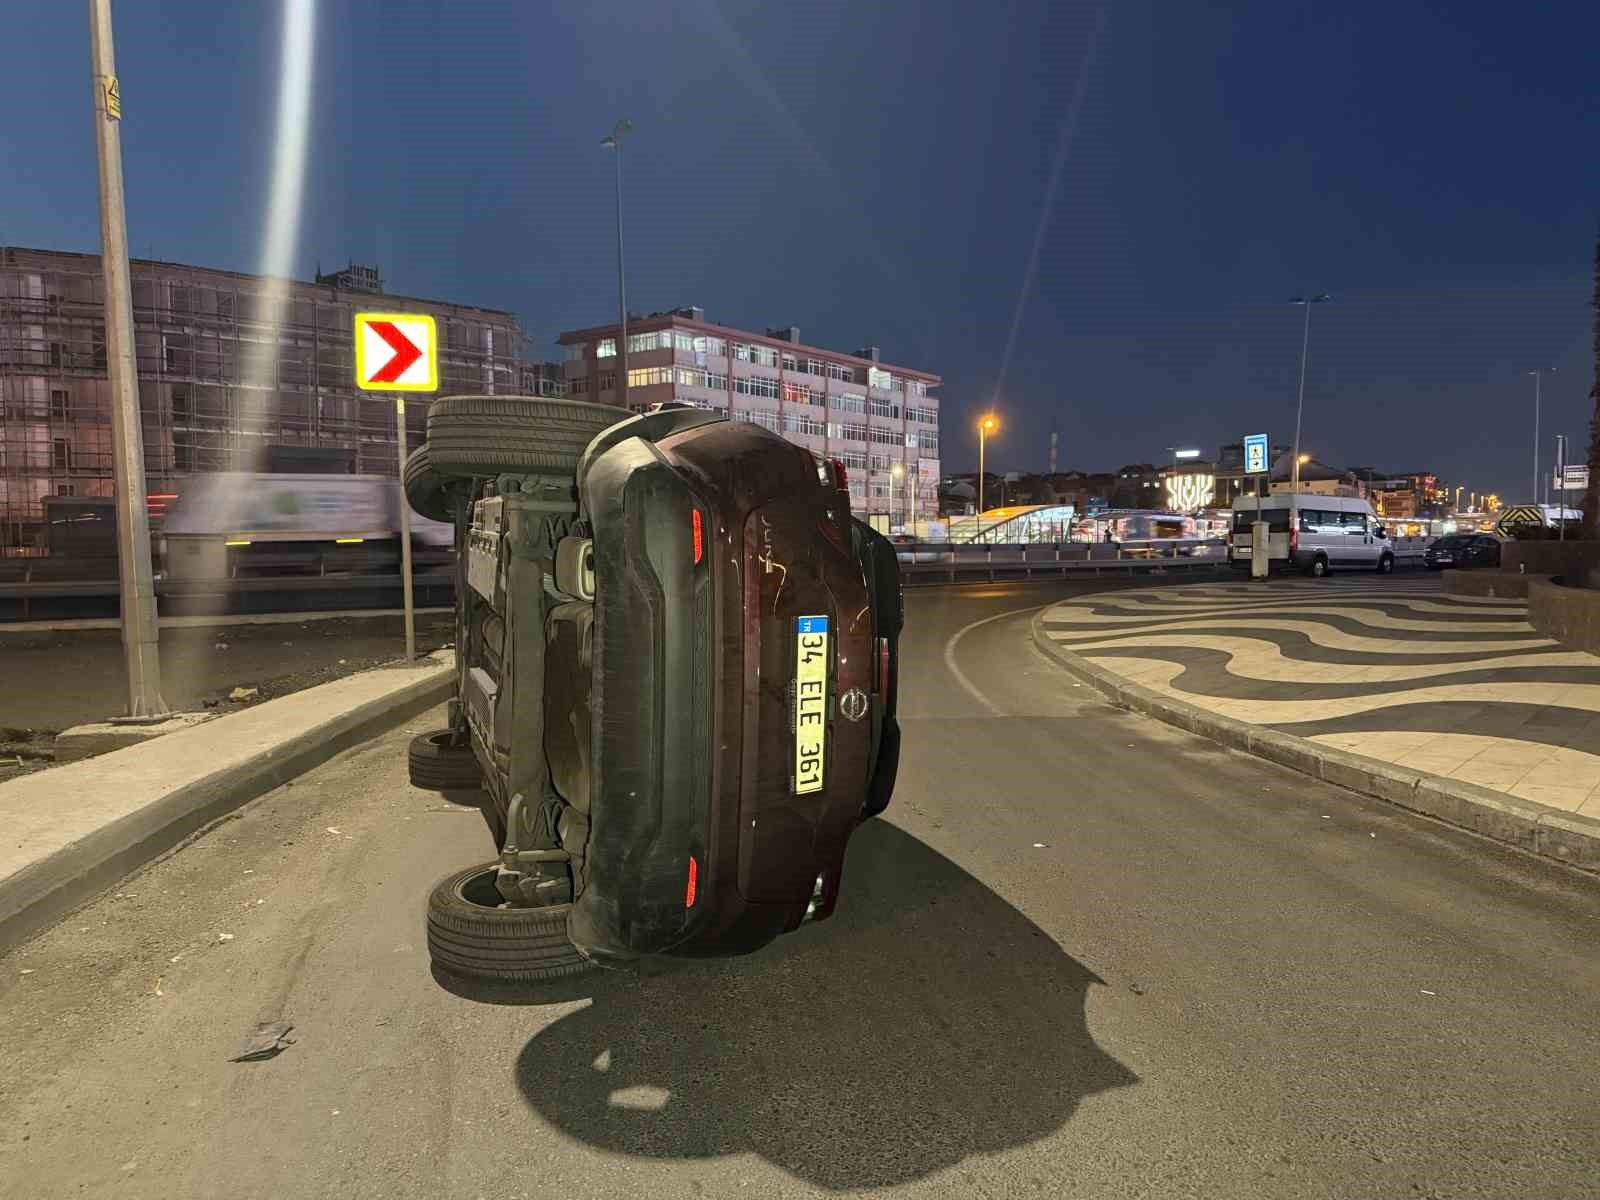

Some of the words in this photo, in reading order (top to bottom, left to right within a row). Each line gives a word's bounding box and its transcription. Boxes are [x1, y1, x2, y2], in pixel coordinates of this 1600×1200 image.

[803, 621, 811, 633] TR
[801, 635, 823, 664] 34
[800, 681, 822, 727] ELE
[800, 742, 820, 785] 361
